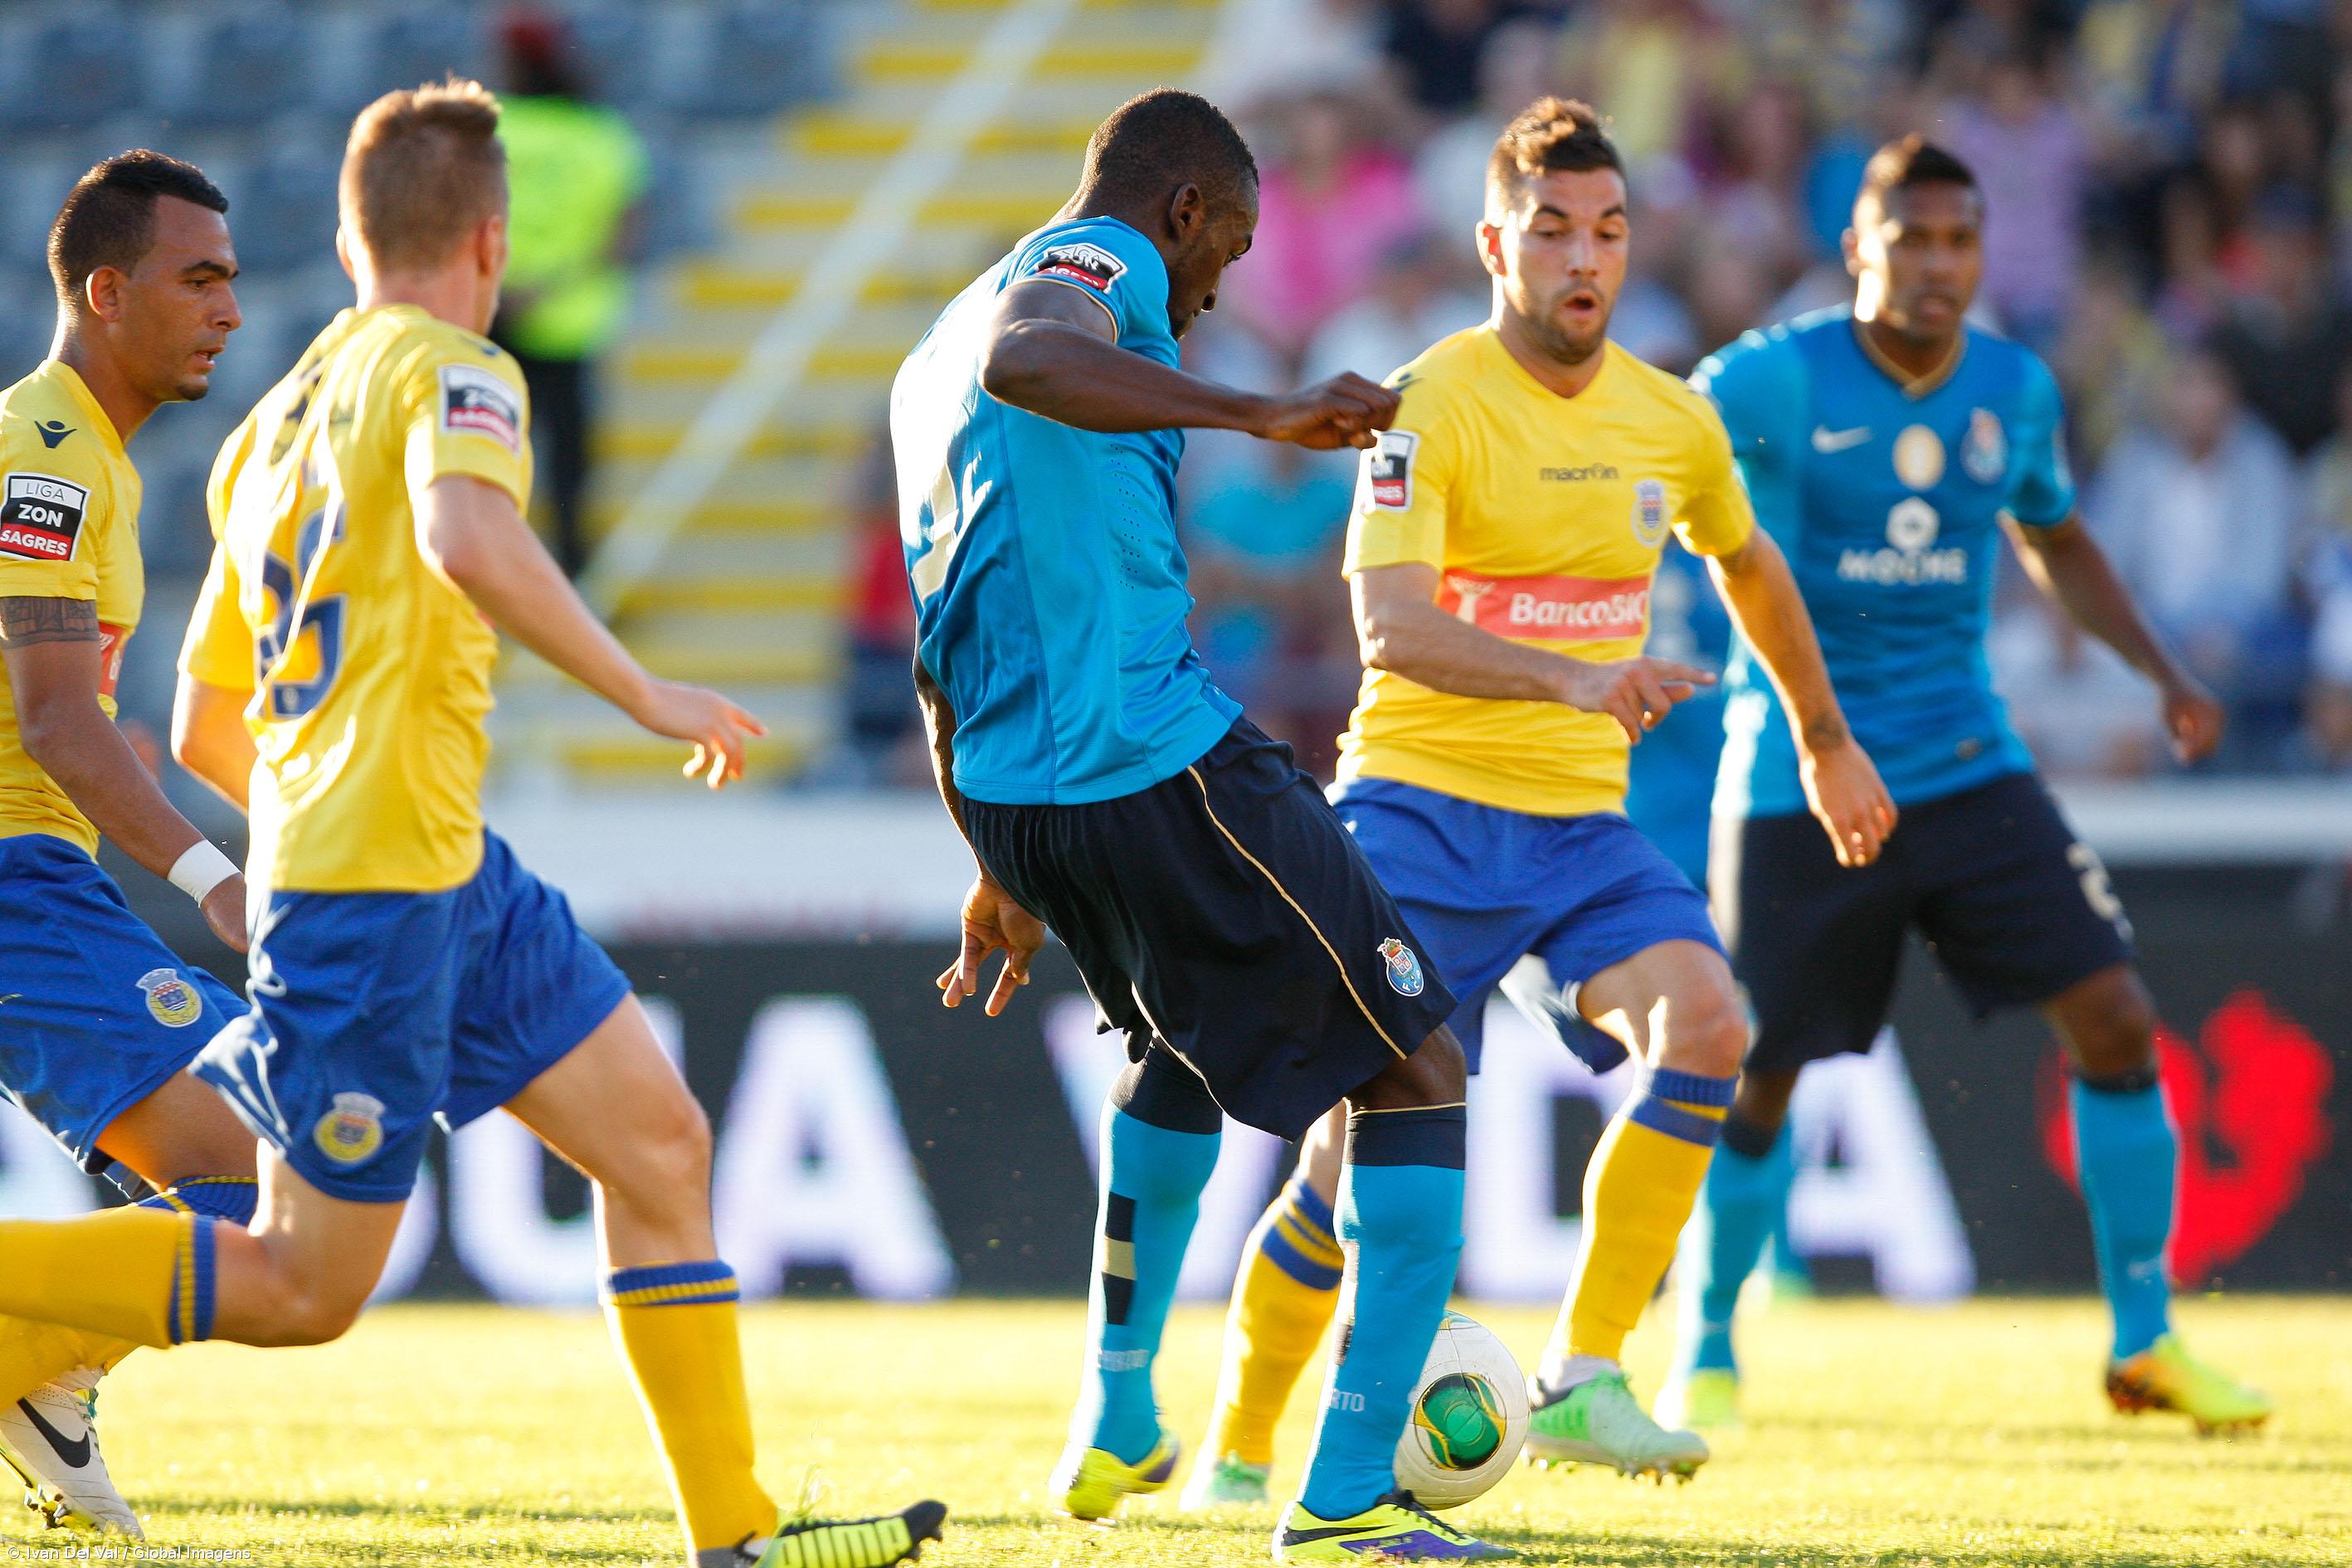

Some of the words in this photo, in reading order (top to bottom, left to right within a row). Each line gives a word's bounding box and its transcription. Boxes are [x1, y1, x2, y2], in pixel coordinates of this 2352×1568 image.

[26, 482, 65, 501] LIGA
[17, 503, 64, 528] ZON
[0, 529, 68, 556] SAGRES
